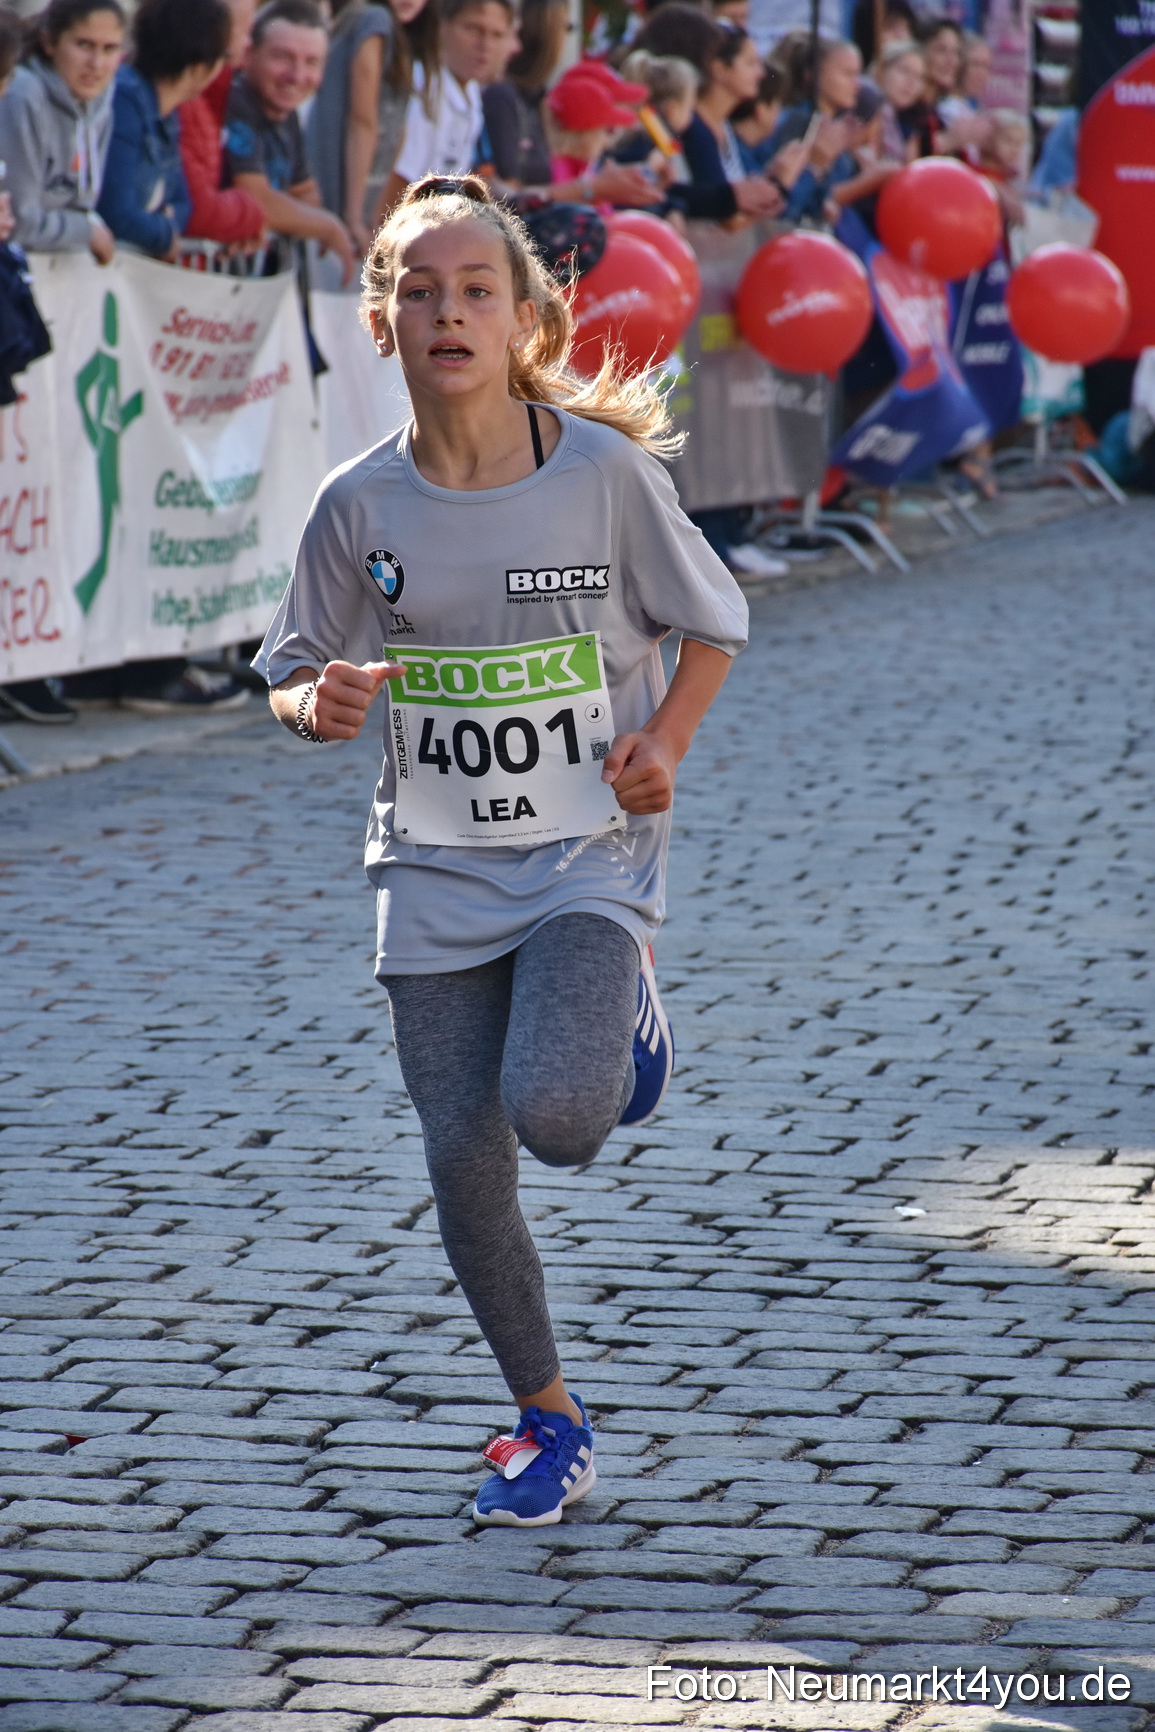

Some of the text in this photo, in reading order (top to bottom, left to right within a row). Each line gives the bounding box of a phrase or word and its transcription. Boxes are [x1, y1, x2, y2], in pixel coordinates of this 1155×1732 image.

[507, 567, 609, 593] BOCK
[507, 591, 609, 605] inspired by smart concept
[391, 614, 412, 627] TL
[400, 649, 576, 696] BOCK
[418, 708, 581, 778] 4001
[470, 796, 538, 823] LEA
[555, 859, 570, 873] 16.
